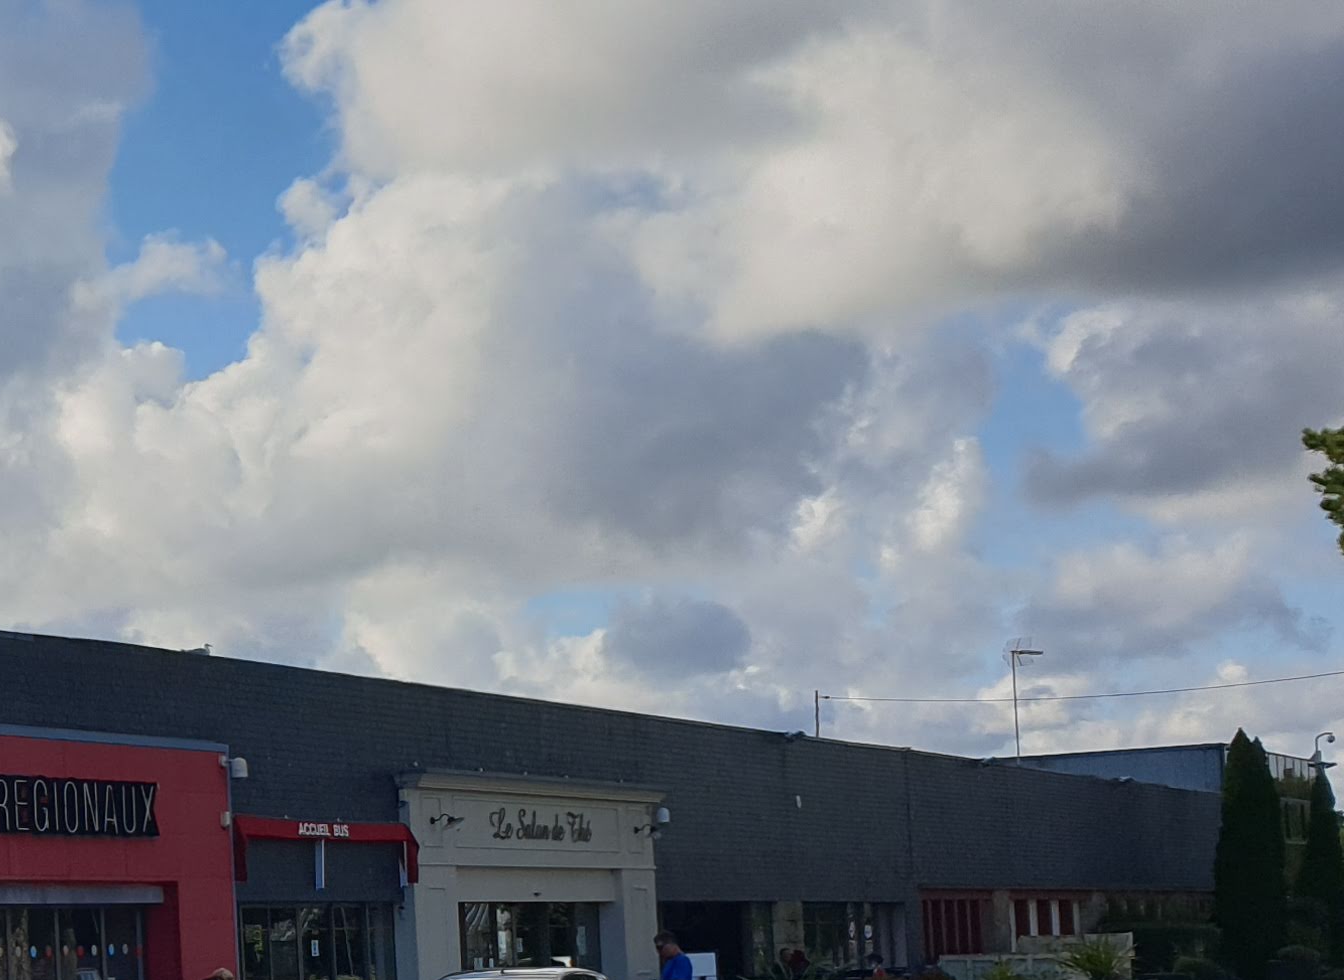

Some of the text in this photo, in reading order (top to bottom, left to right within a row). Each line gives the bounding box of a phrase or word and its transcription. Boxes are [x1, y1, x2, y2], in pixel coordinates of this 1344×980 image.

[298, 822, 349, 837] ACCUEIL BUS
[489, 807, 512, 840] Le
[516, 808, 550, 840] Salon
[551, 813, 565, 841] de
